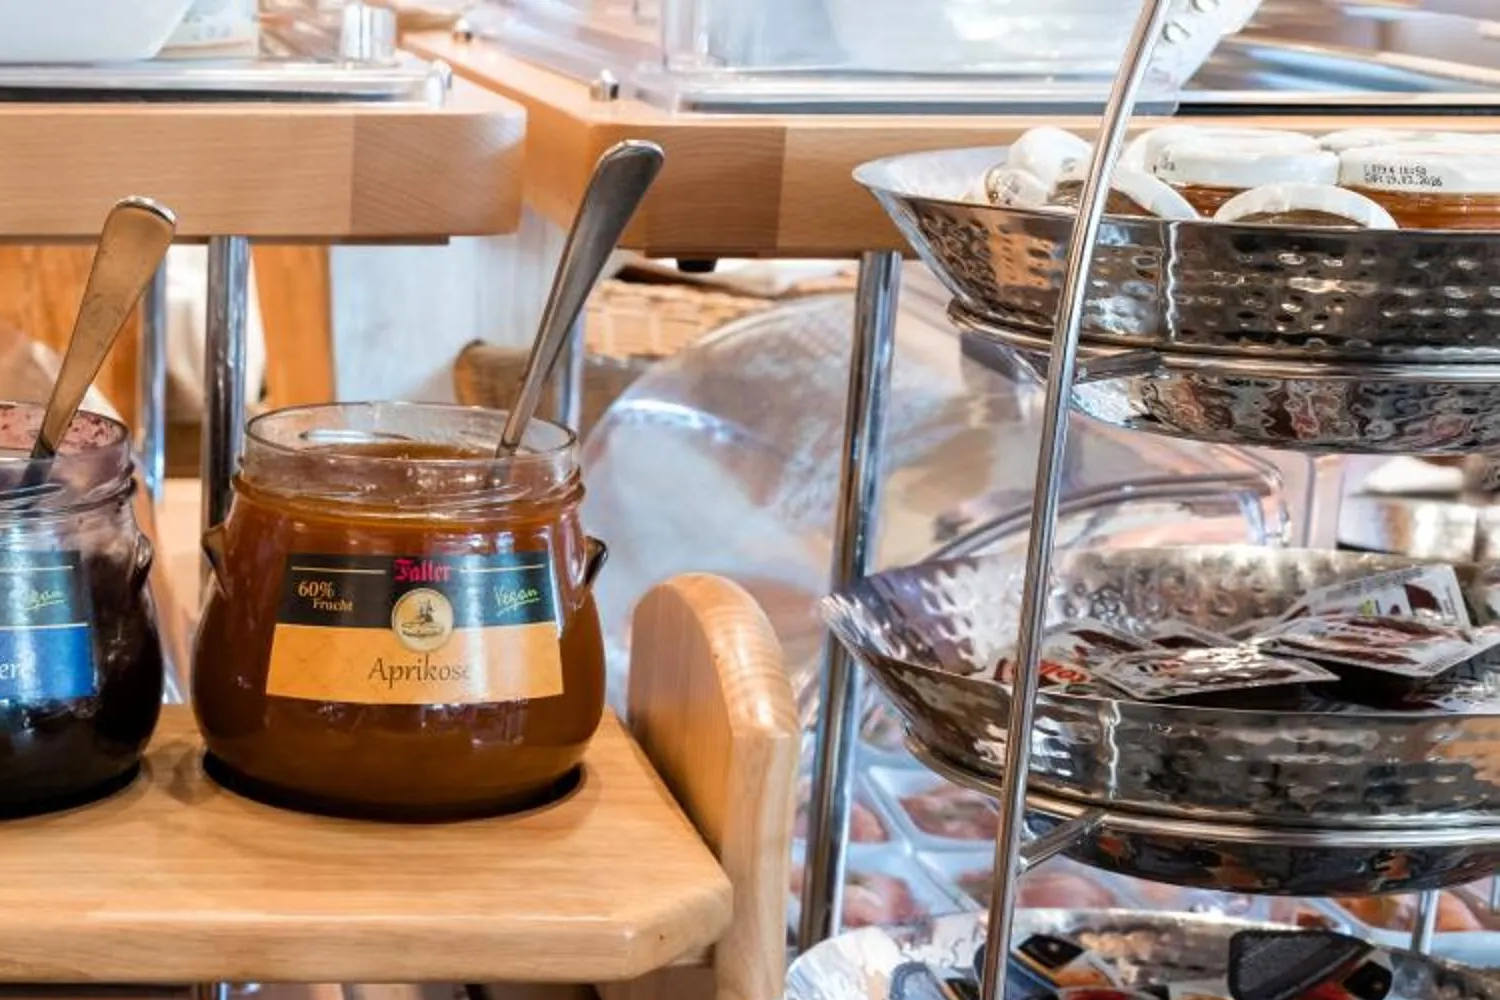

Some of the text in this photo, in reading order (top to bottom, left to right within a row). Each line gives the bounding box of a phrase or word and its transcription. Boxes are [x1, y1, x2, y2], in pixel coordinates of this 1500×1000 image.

[394, 559, 452, 583] Faller
[298, 581, 334, 598] 60%
[494, 586, 540, 612] Vegan
